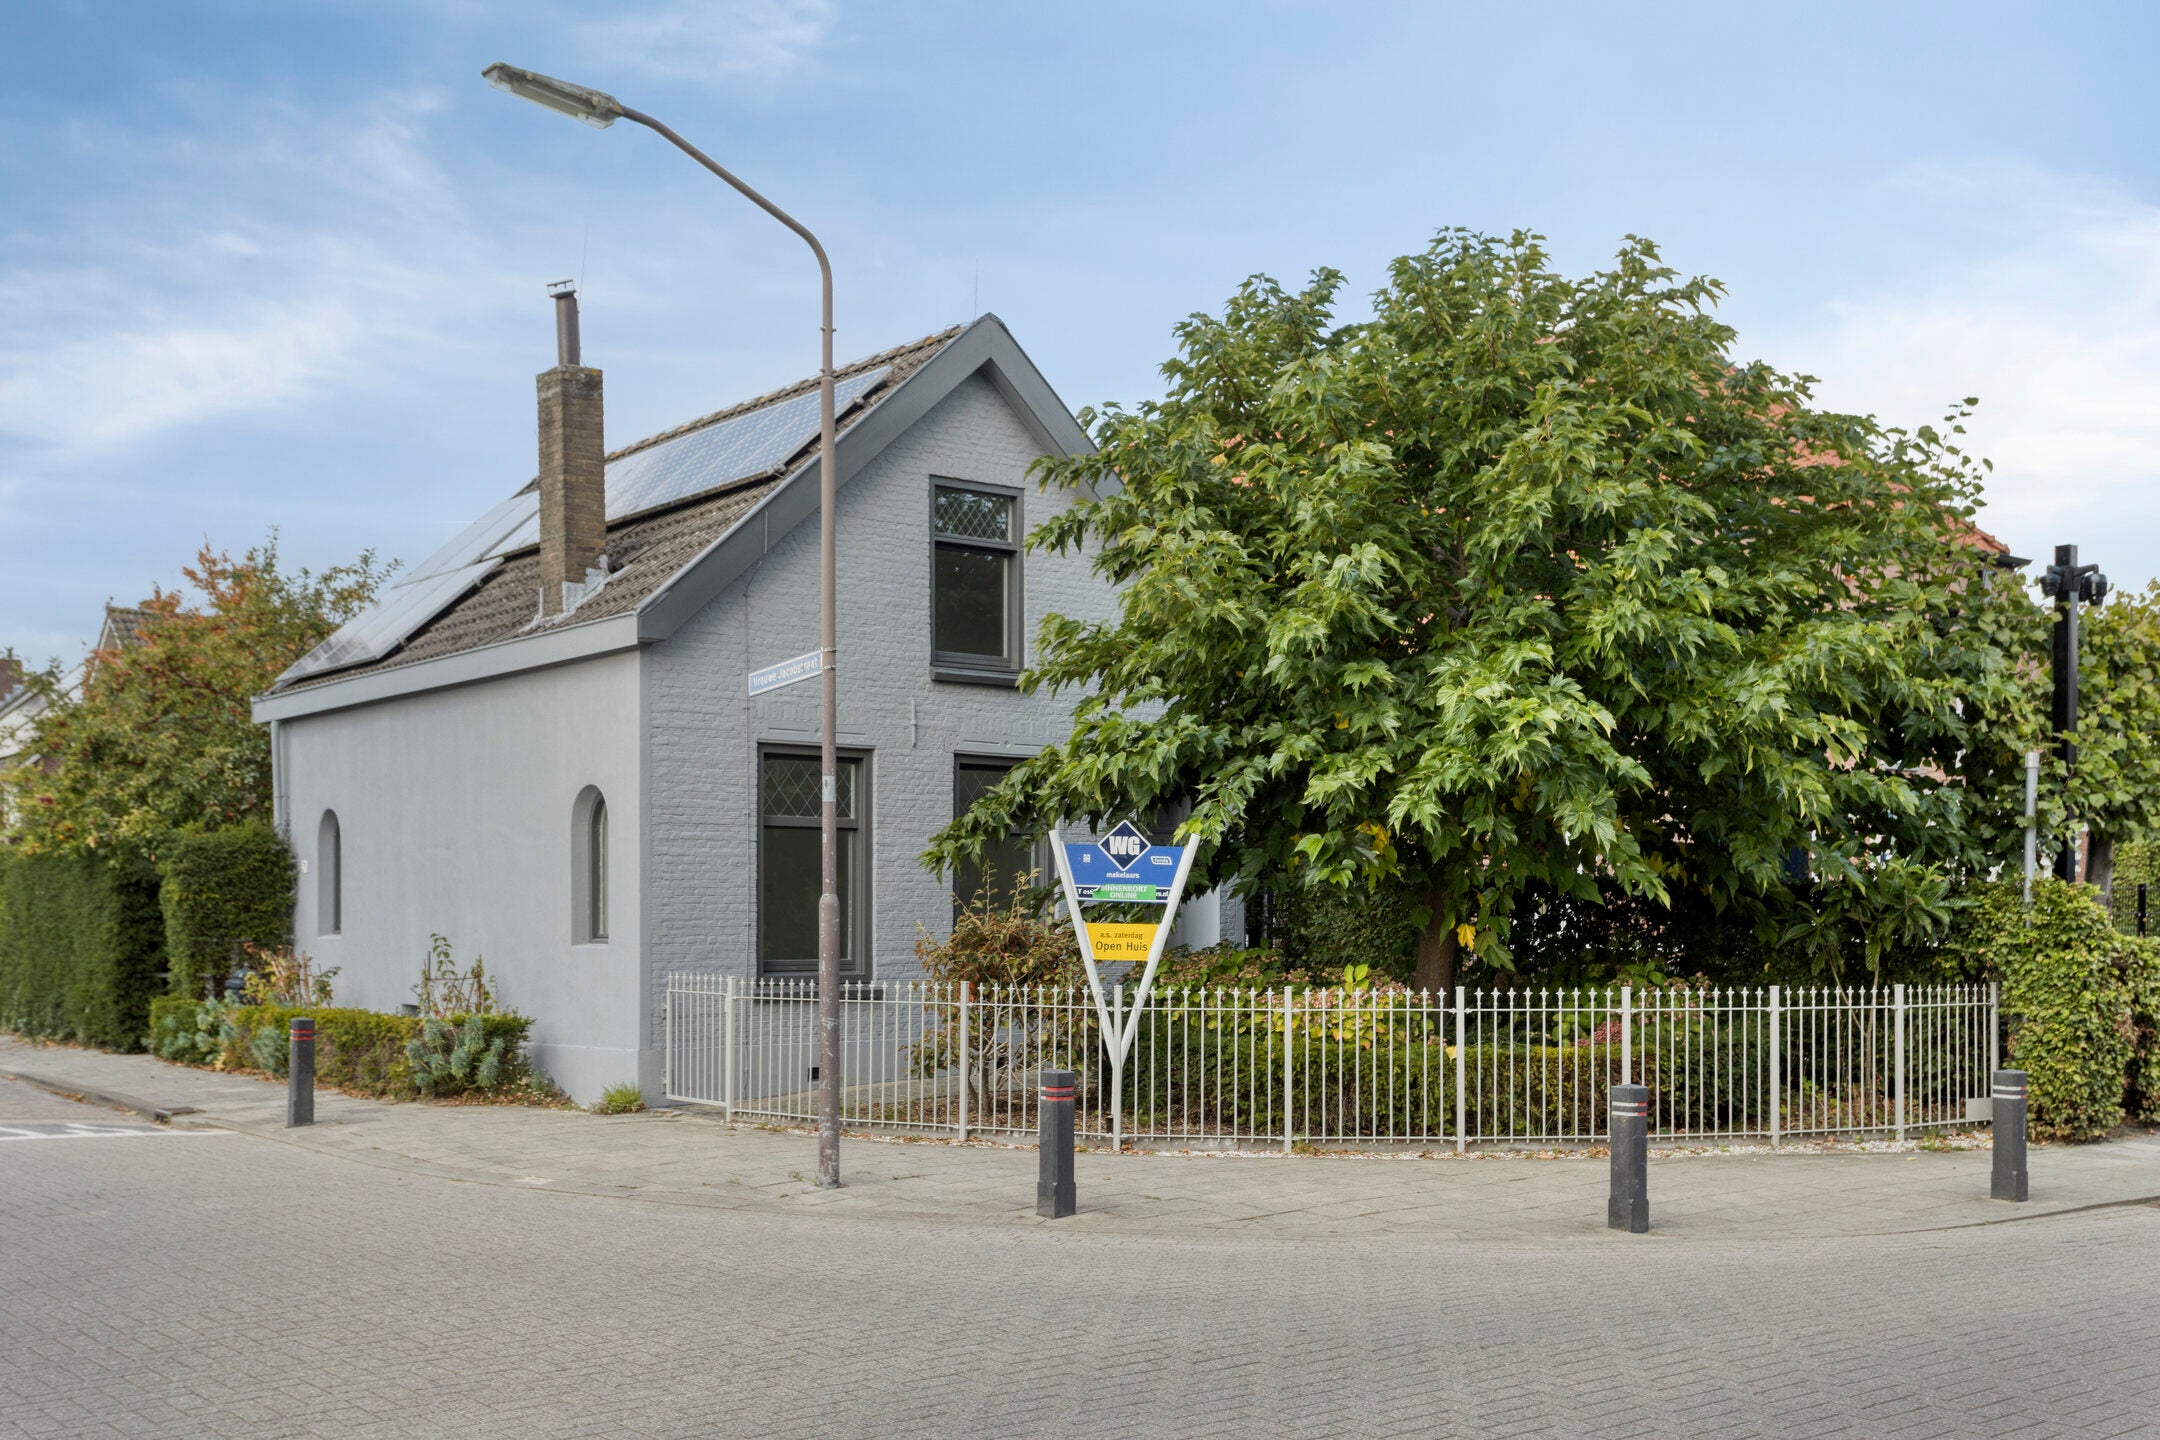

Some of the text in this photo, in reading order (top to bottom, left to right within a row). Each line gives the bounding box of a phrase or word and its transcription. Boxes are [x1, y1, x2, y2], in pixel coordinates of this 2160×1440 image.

[753, 673, 777, 688] Vrouwe
[1109, 836, 1140, 855] WG
[1101, 885, 1147, 893] BINNENKORT
[1114, 932, 1143, 940] zaterdag
[1096, 941, 1148, 952] Open Huis
